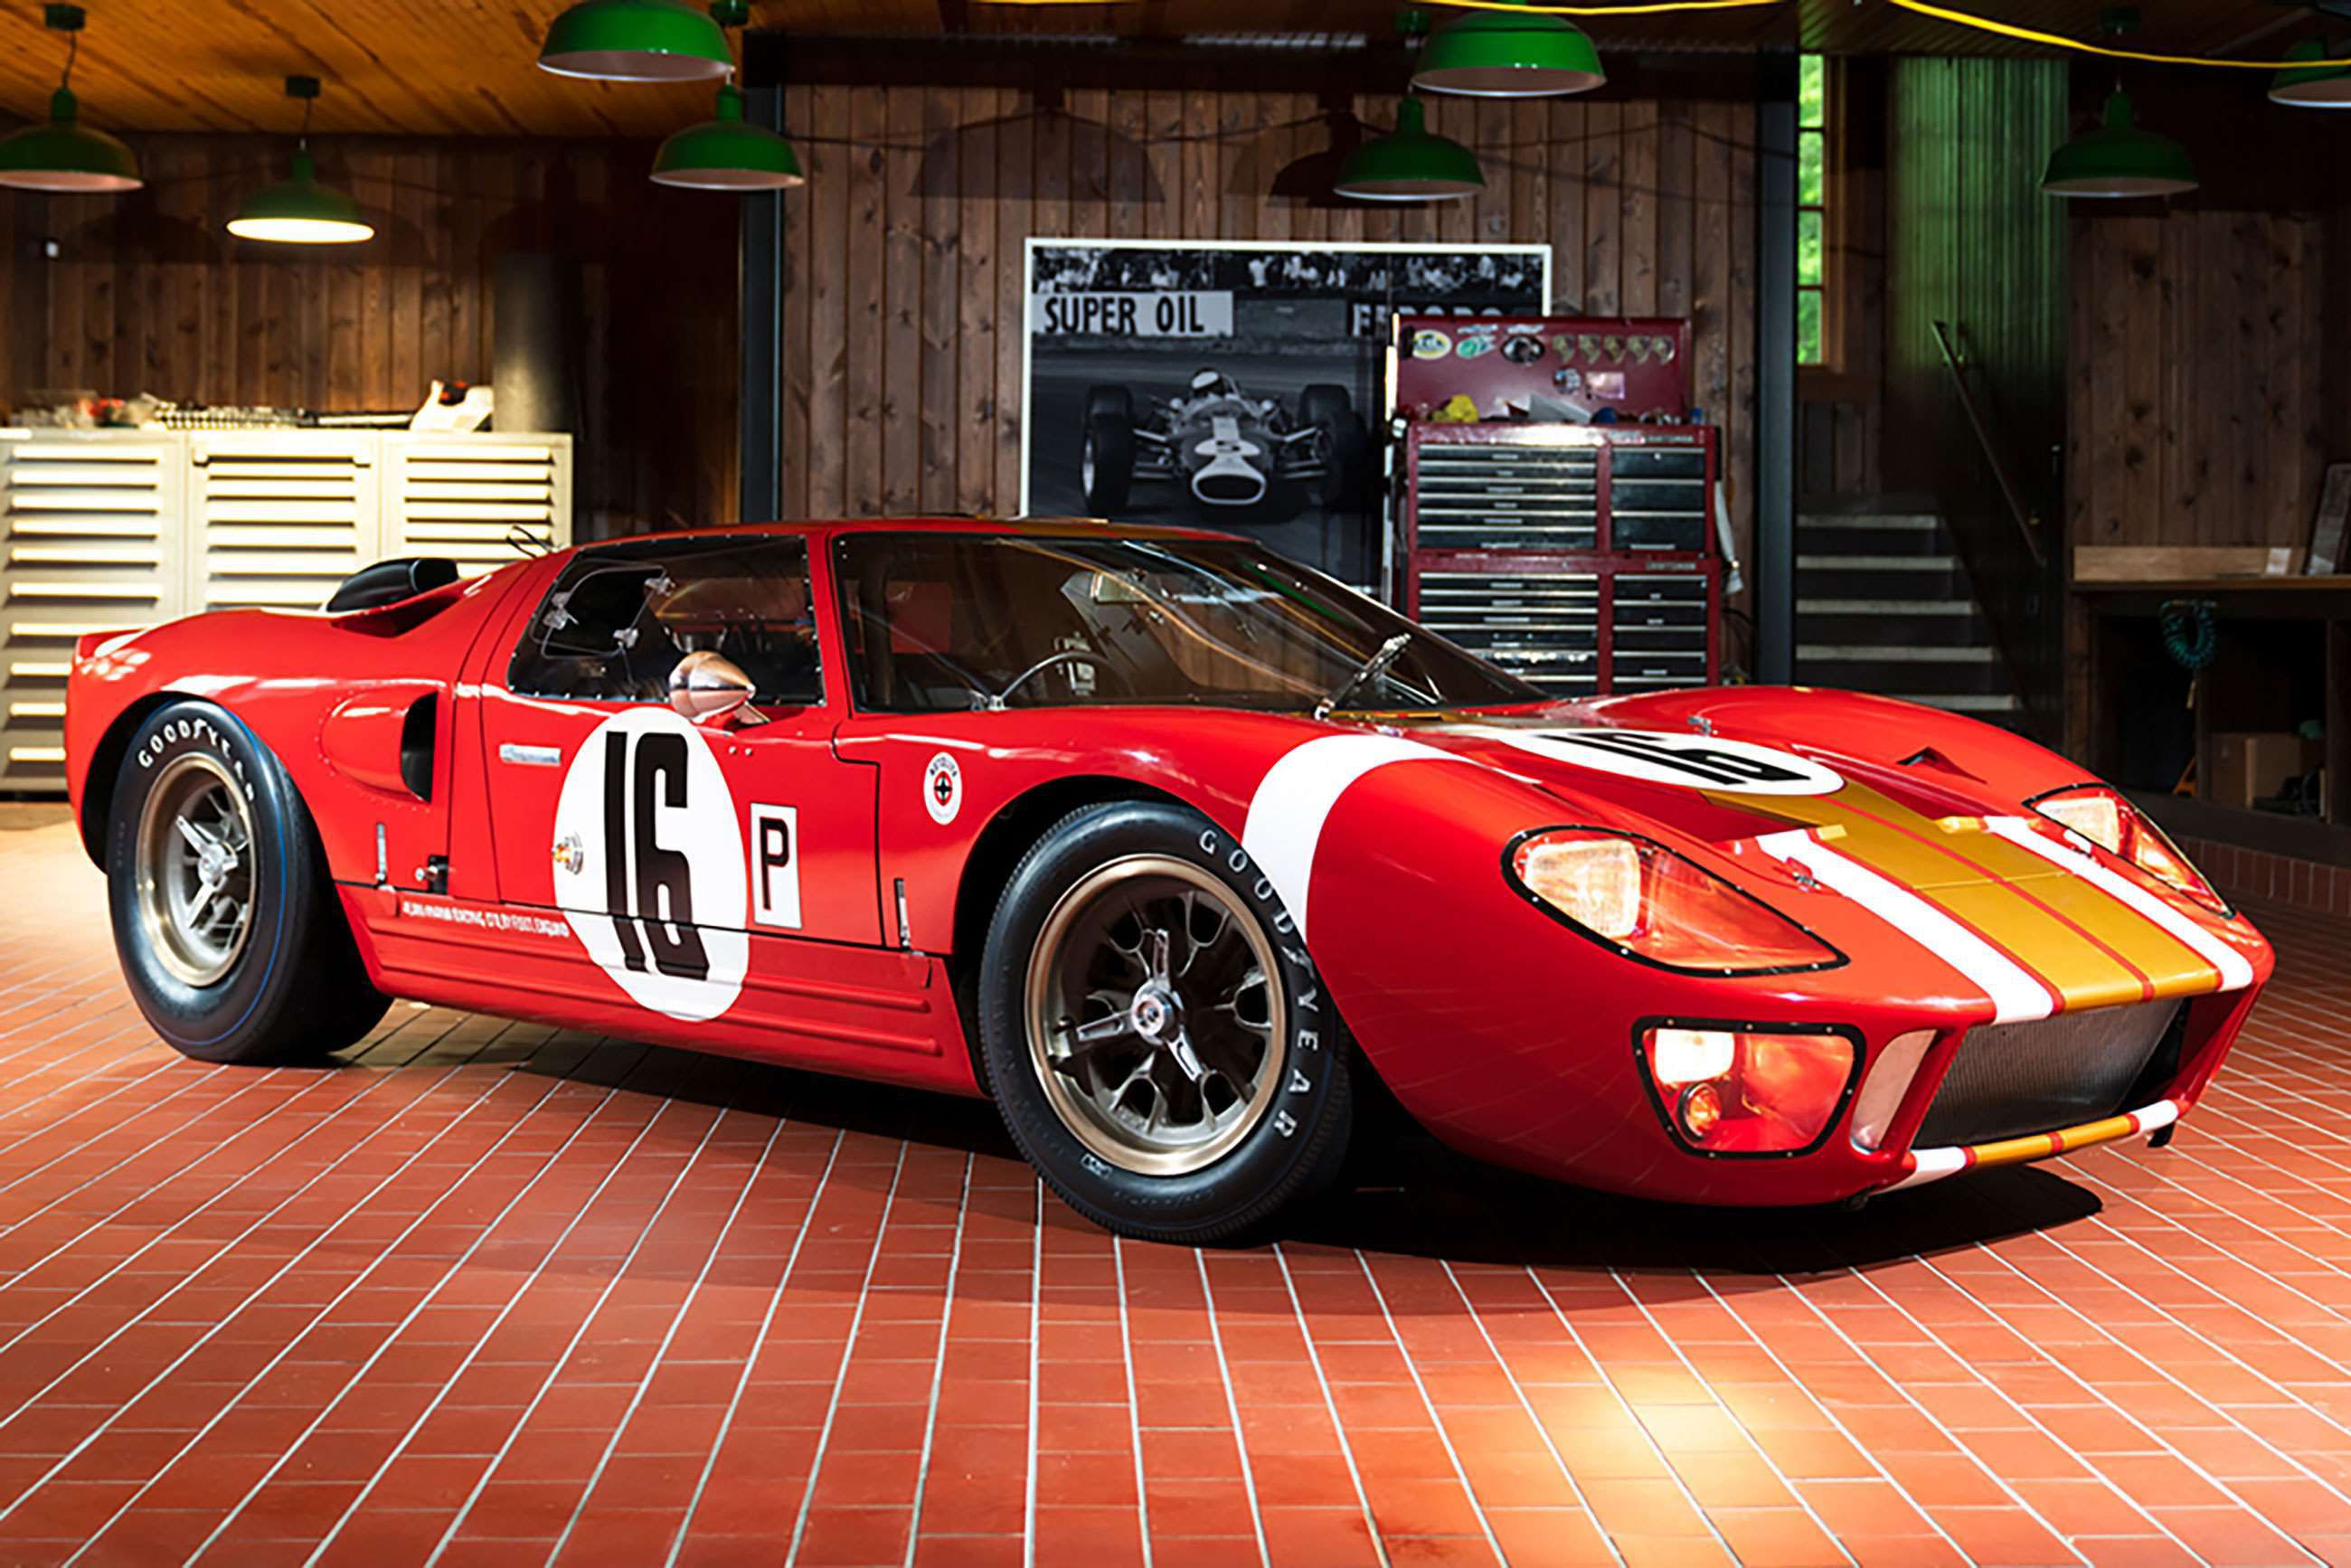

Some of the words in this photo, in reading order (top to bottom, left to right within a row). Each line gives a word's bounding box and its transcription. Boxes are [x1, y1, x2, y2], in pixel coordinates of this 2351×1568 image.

[1044, 296, 1137, 335] SUPER
[1156, 295, 1204, 333] OIL
[604, 731, 710, 981] 16
[759, 816, 790, 912] P
[1199, 829, 1319, 1138] GOODYEAR
